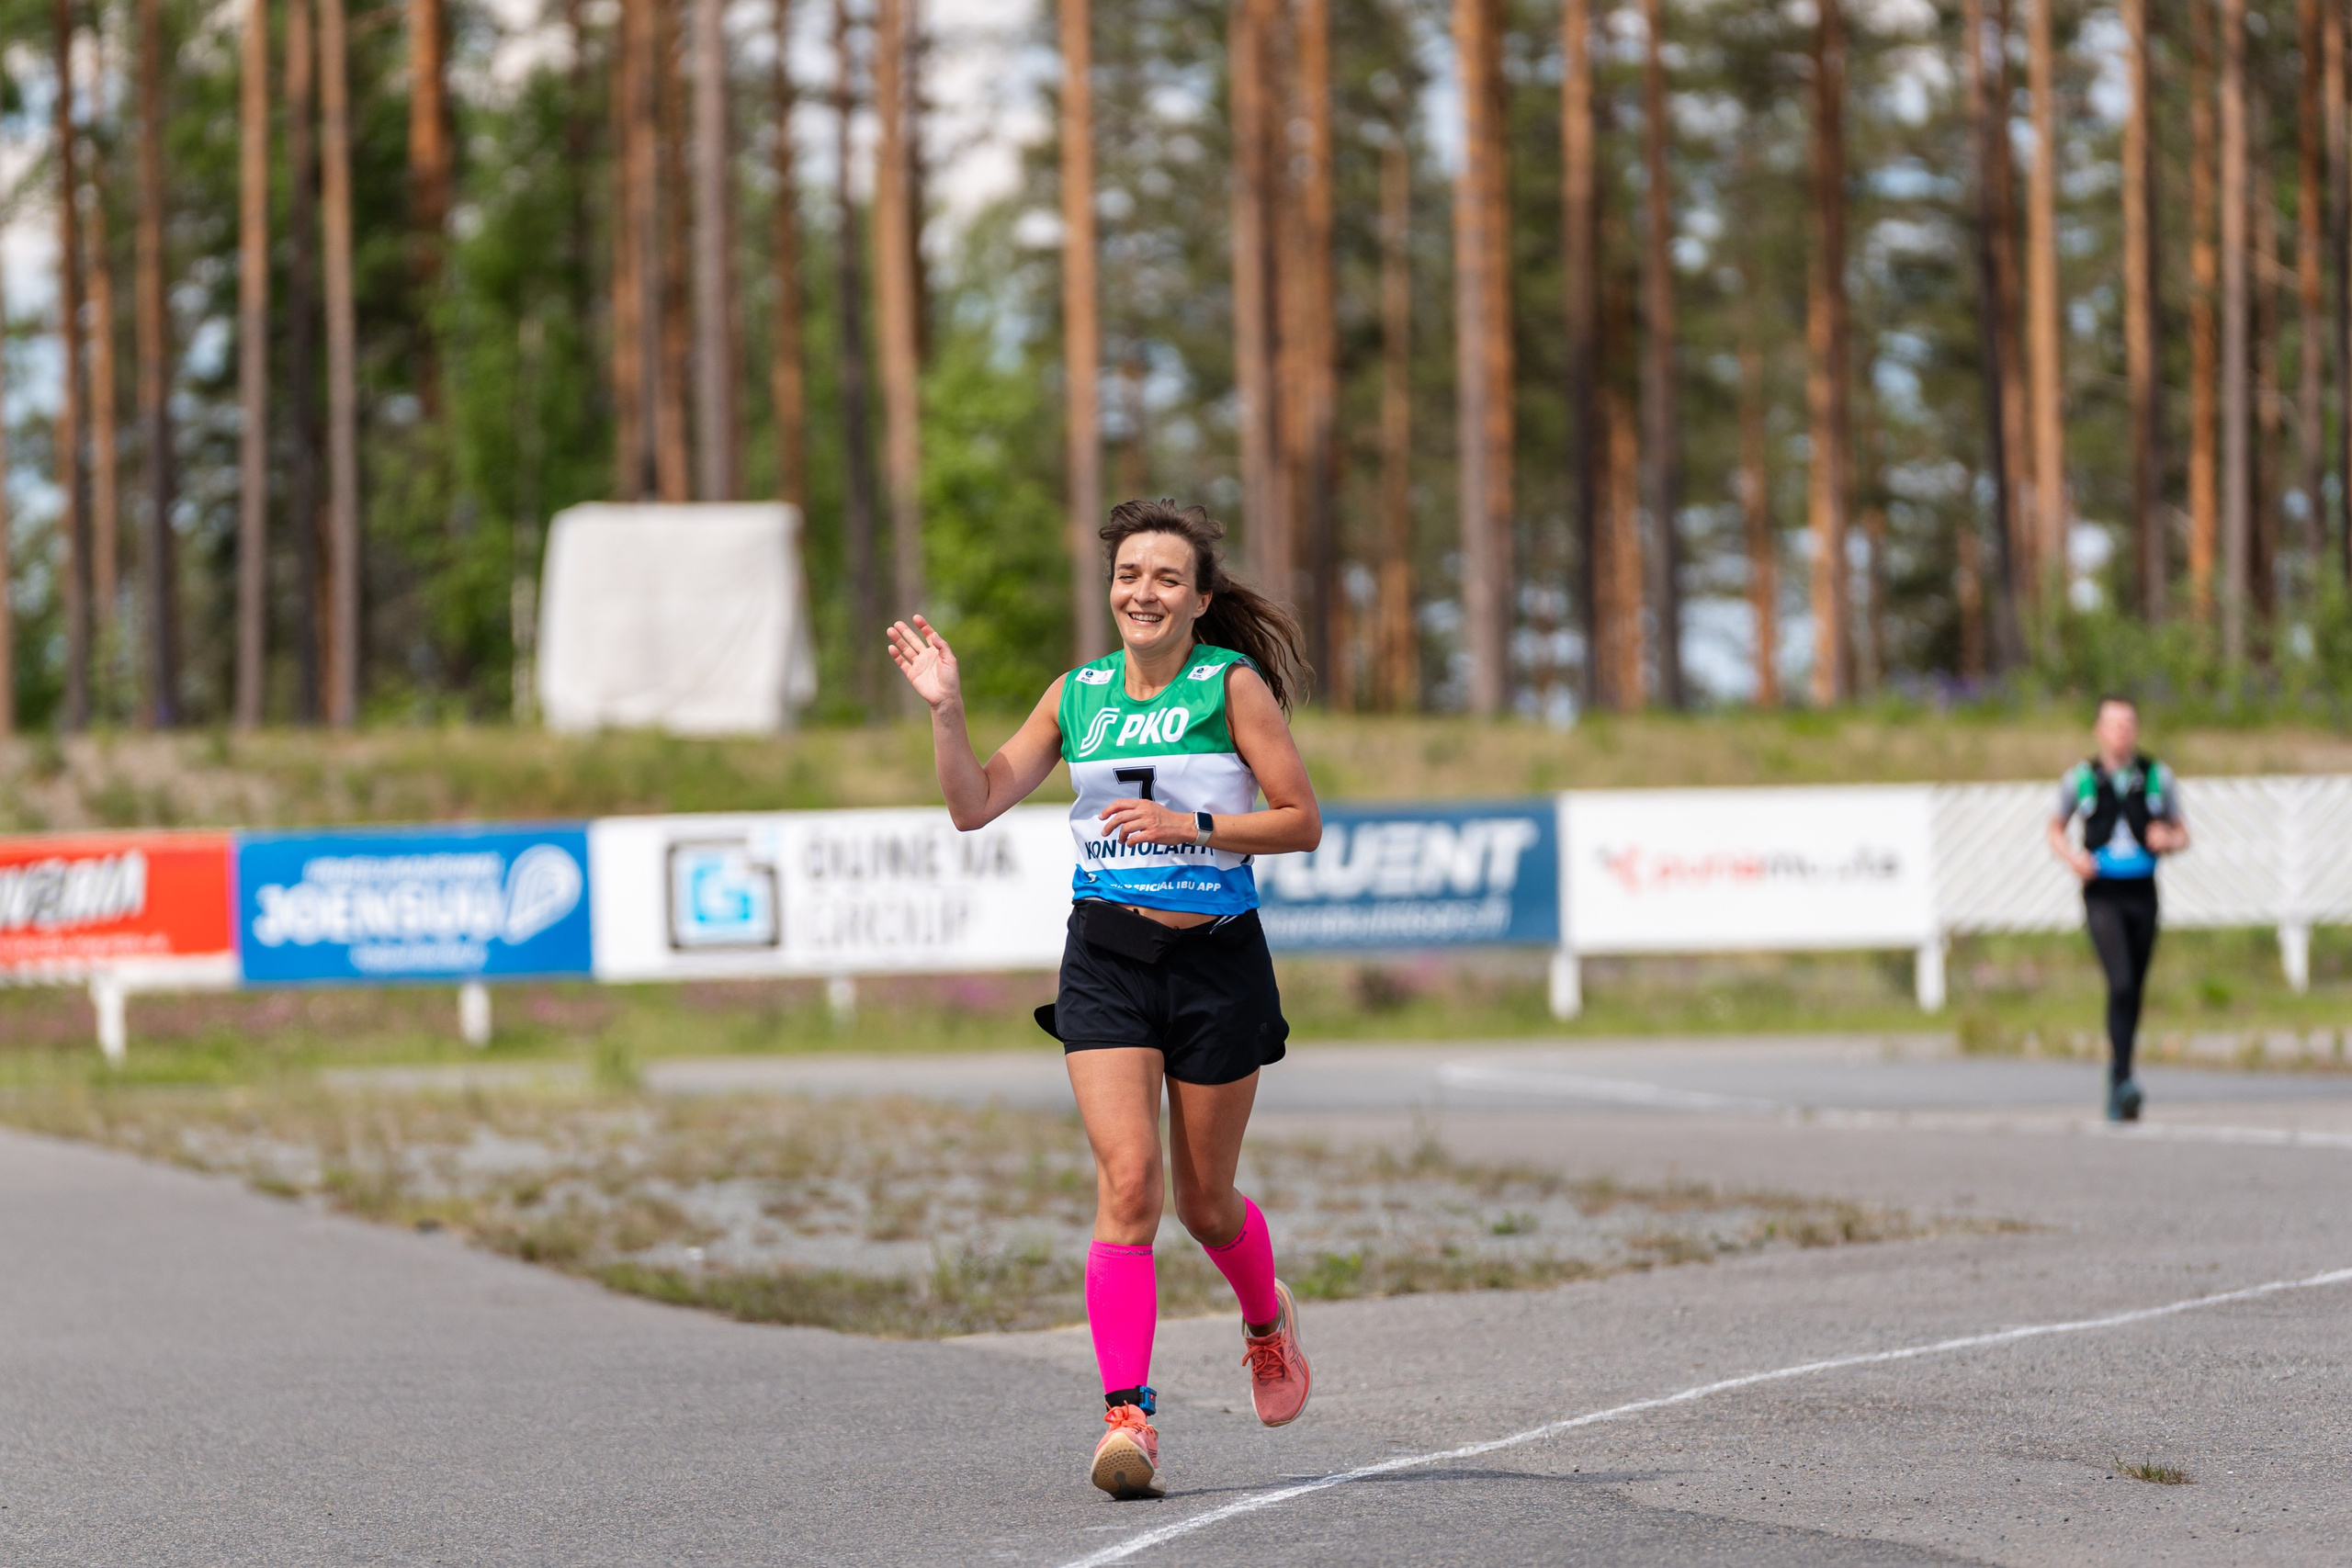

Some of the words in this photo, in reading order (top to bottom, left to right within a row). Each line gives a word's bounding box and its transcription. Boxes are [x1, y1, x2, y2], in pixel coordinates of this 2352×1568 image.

[1115, 706, 1190, 747] PKO
[1113, 765, 1158, 802] 7
[1176, 881, 1195, 890] IBU
[1197, 882, 1222, 892] APP
[254, 882, 503, 945] JOENSUU
